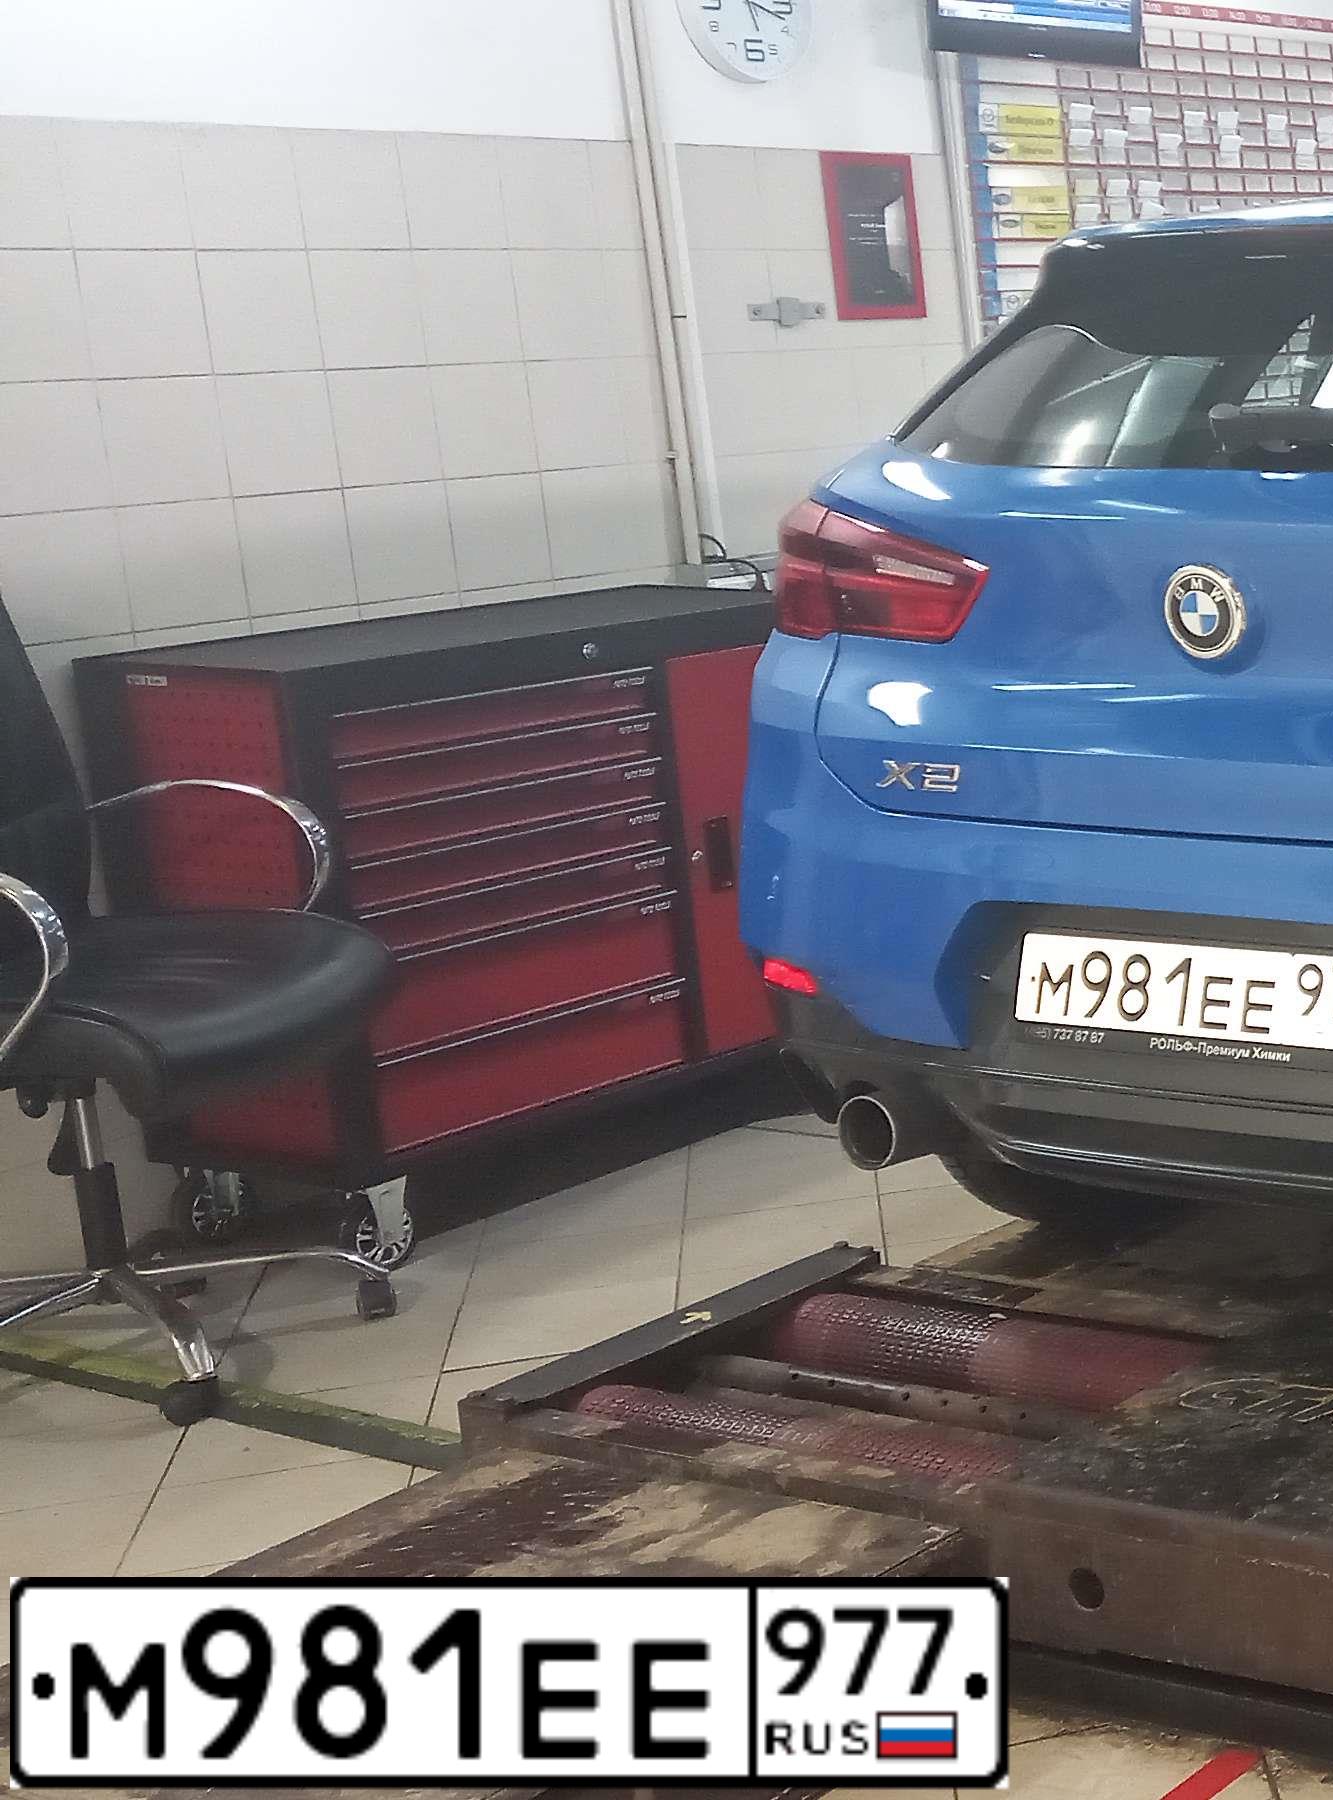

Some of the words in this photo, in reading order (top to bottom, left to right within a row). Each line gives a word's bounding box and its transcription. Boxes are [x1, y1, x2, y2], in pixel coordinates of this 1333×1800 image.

[743, 39, 765, 62] 6
[1175, 576, 1226, 603] BMW
[875, 759, 960, 792] X2
[1035, 950, 1276, 1034] М981ЕЕ
[1053, 1028, 1073, 1041] 737
[1074, 1029, 1088, 1042] 87
[1090, 1031, 1104, 1044] 87
[1150, 1036, 1250, 1060] РОЛЬФ-Премиум
[1251, 1047, 1291, 1063] Химки
